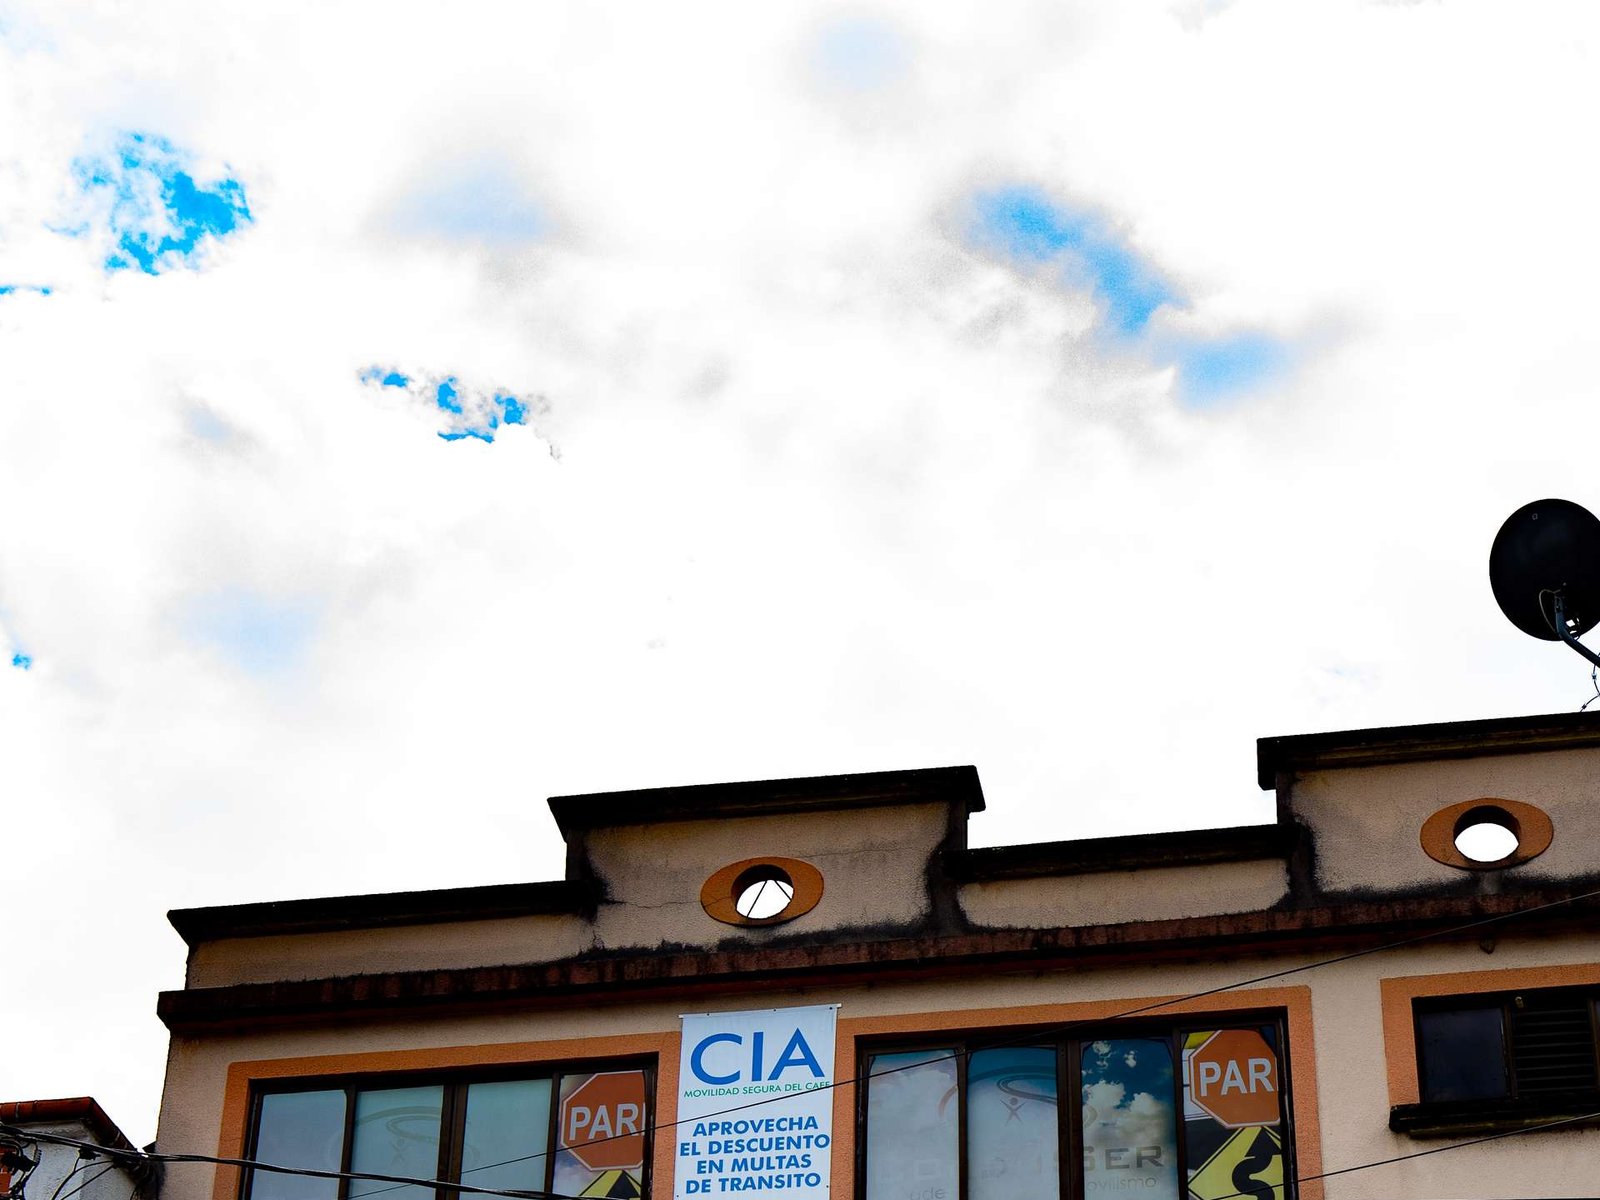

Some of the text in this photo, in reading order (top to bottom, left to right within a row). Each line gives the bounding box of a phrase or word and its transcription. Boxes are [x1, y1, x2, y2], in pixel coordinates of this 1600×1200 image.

[690, 1027, 825, 1085] CIA
[1200, 1058, 1278, 1097] PAR
[683, 1086, 740, 1098] MOVILIDAD
[742, 1084, 781, 1094] SEGURA
[784, 1082, 802, 1092] DEL
[569, 1102, 645, 1141] PAR
[692, 1116, 818, 1137] APROVECHA
[680, 1134, 830, 1157] EL DESCUENTO
[696, 1154, 812, 1174] EN MULTAS
[686, 1173, 821, 1194] DE TRANSITO
